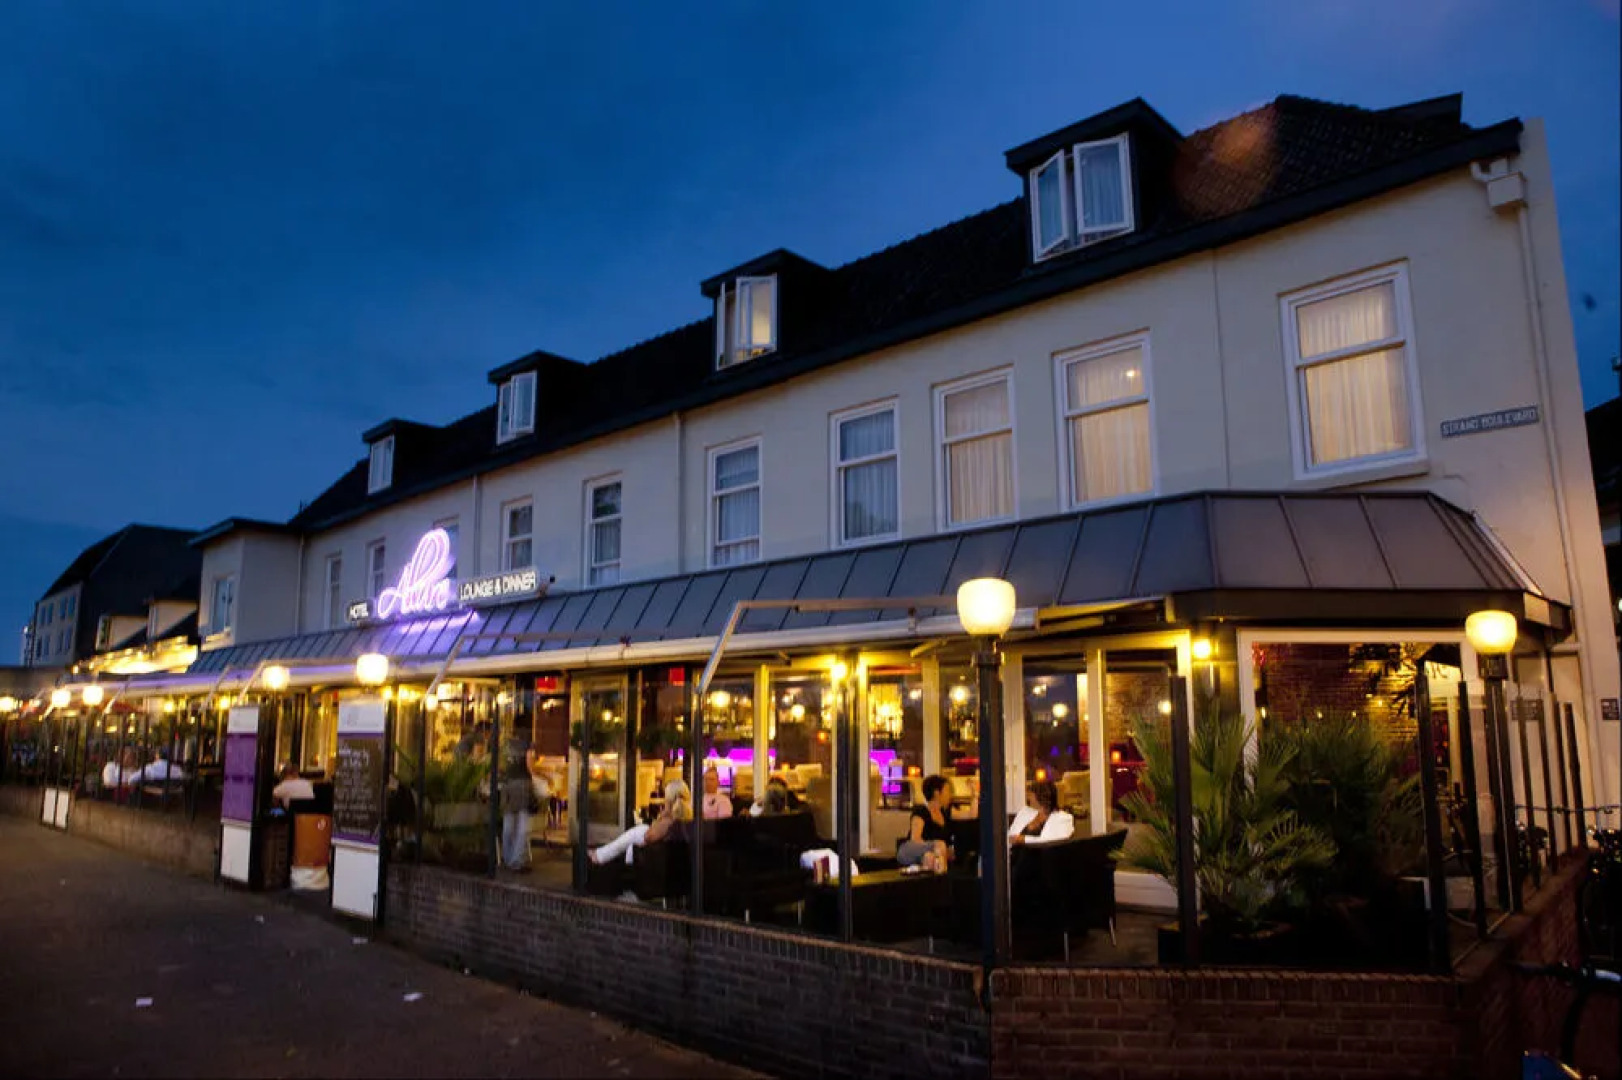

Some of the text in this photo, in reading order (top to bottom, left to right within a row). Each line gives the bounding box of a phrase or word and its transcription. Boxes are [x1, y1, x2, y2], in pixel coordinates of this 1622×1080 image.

[460, 571, 536, 601] LOUNGE & DINNER
